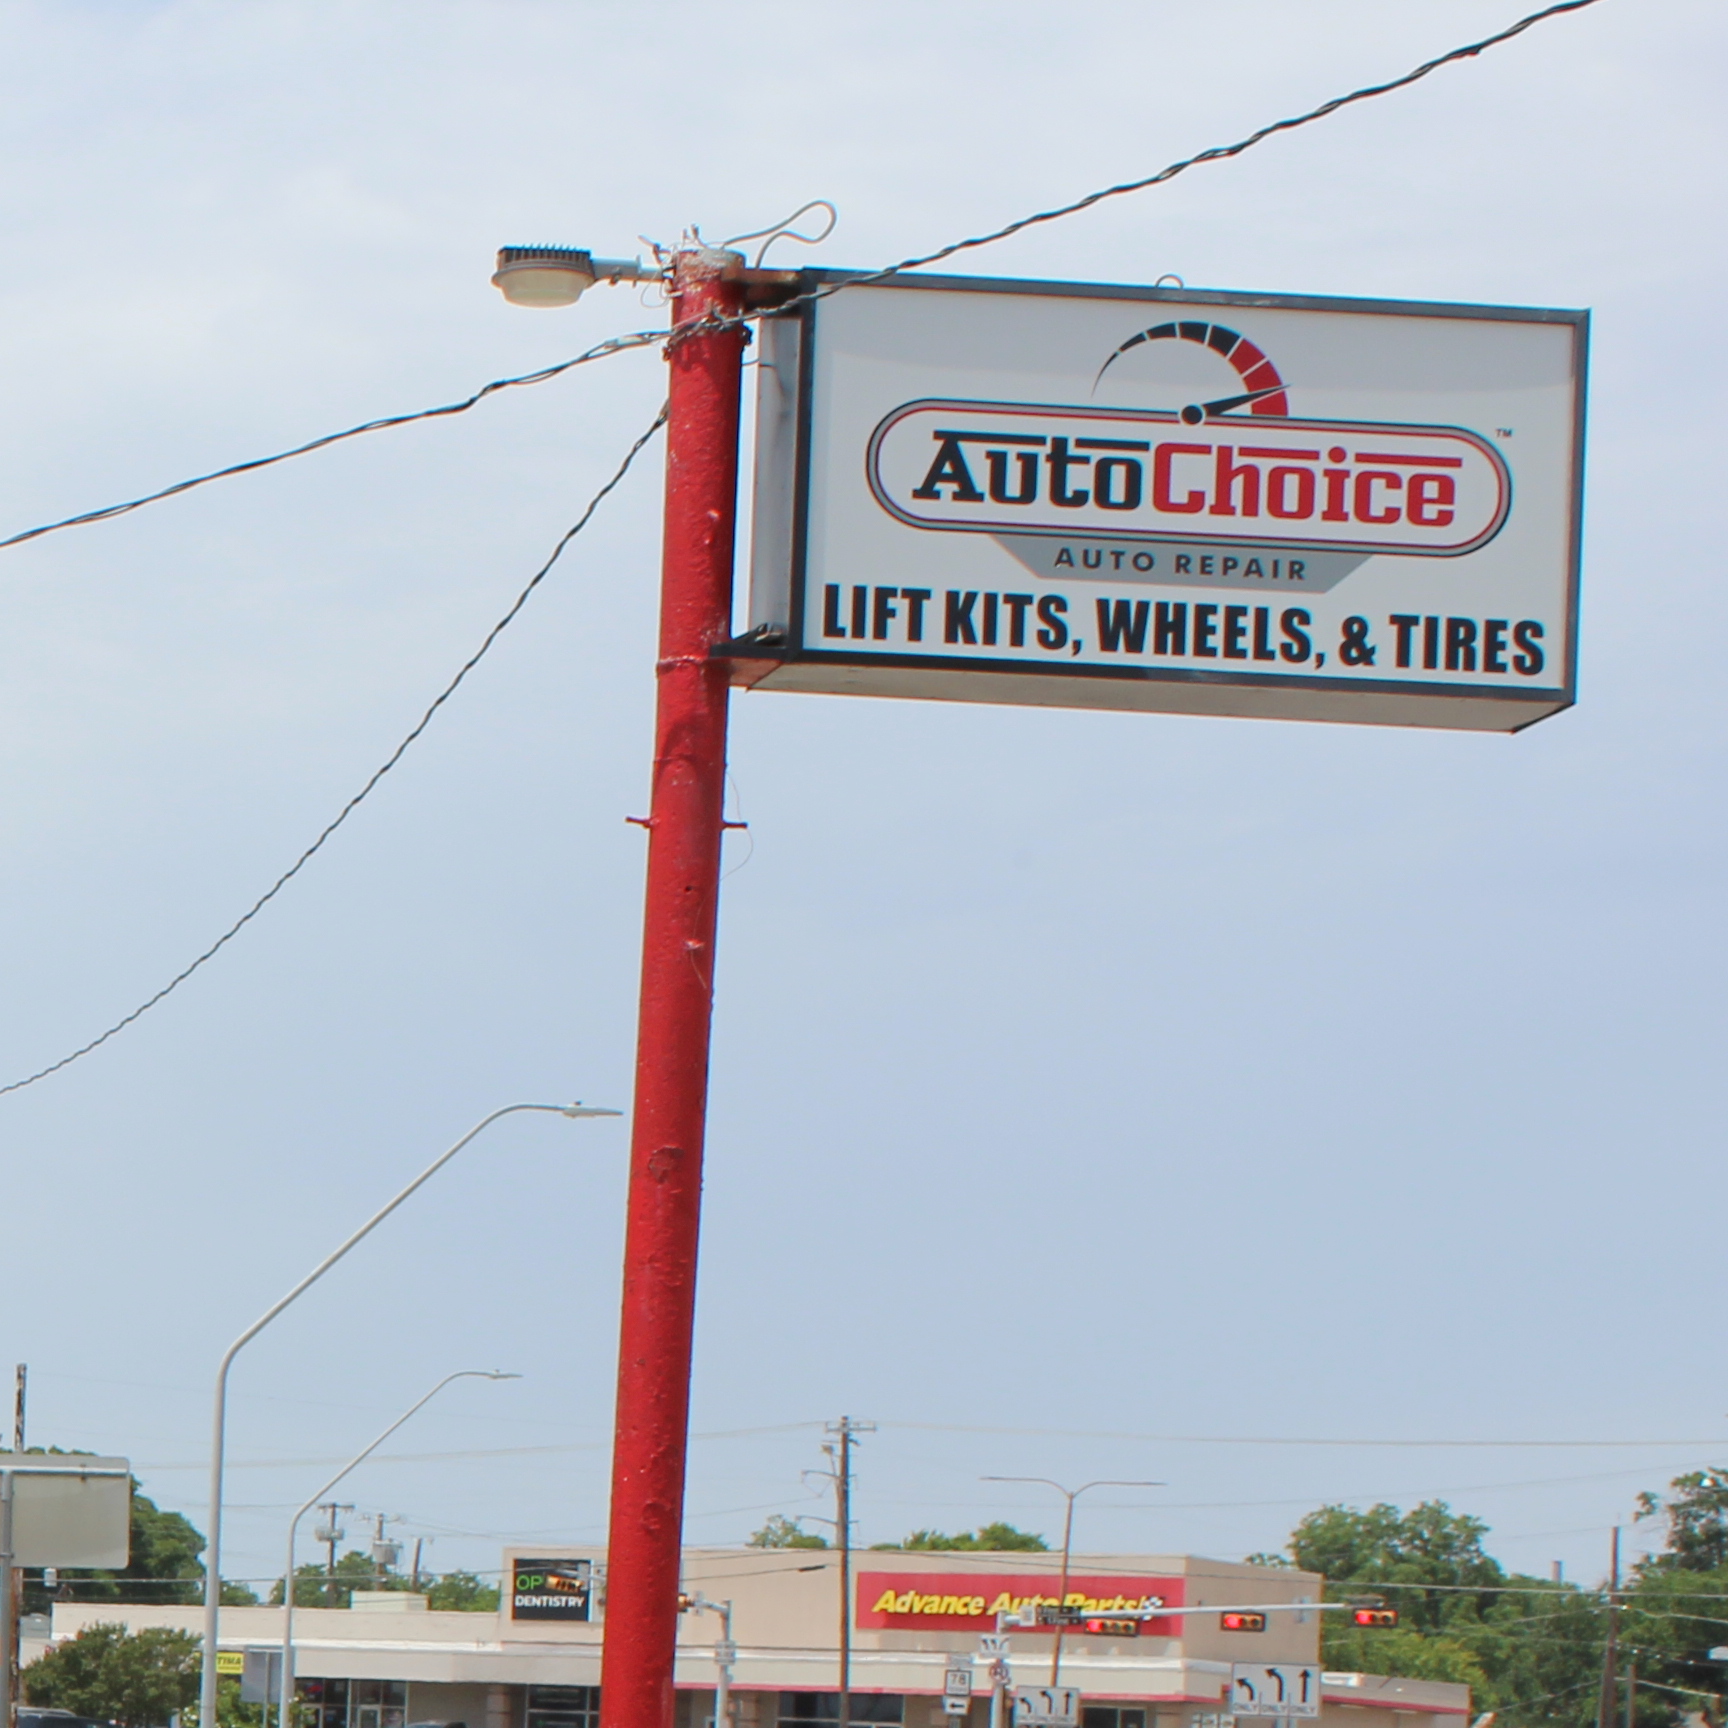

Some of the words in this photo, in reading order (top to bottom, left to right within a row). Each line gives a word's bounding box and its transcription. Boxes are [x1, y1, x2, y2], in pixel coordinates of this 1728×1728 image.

[912, 430, 1463, 528] AutoChoice
[1055, 547, 1155, 571] AUTO
[1176, 554, 1305, 579] REPAIR
[824, 583, 932, 642] LIFT
[942, 590, 1084, 657] KITS,
[1095, 598, 1327, 671] WHEELS,
[1339, 617, 1377, 666] &
[1390, 614, 1545, 675] TIRES
[515, 1595, 585, 1607] DENTISTRY
[872, 1589, 985, 1615] Advance
[950, 1673, 966, 1685] 78
